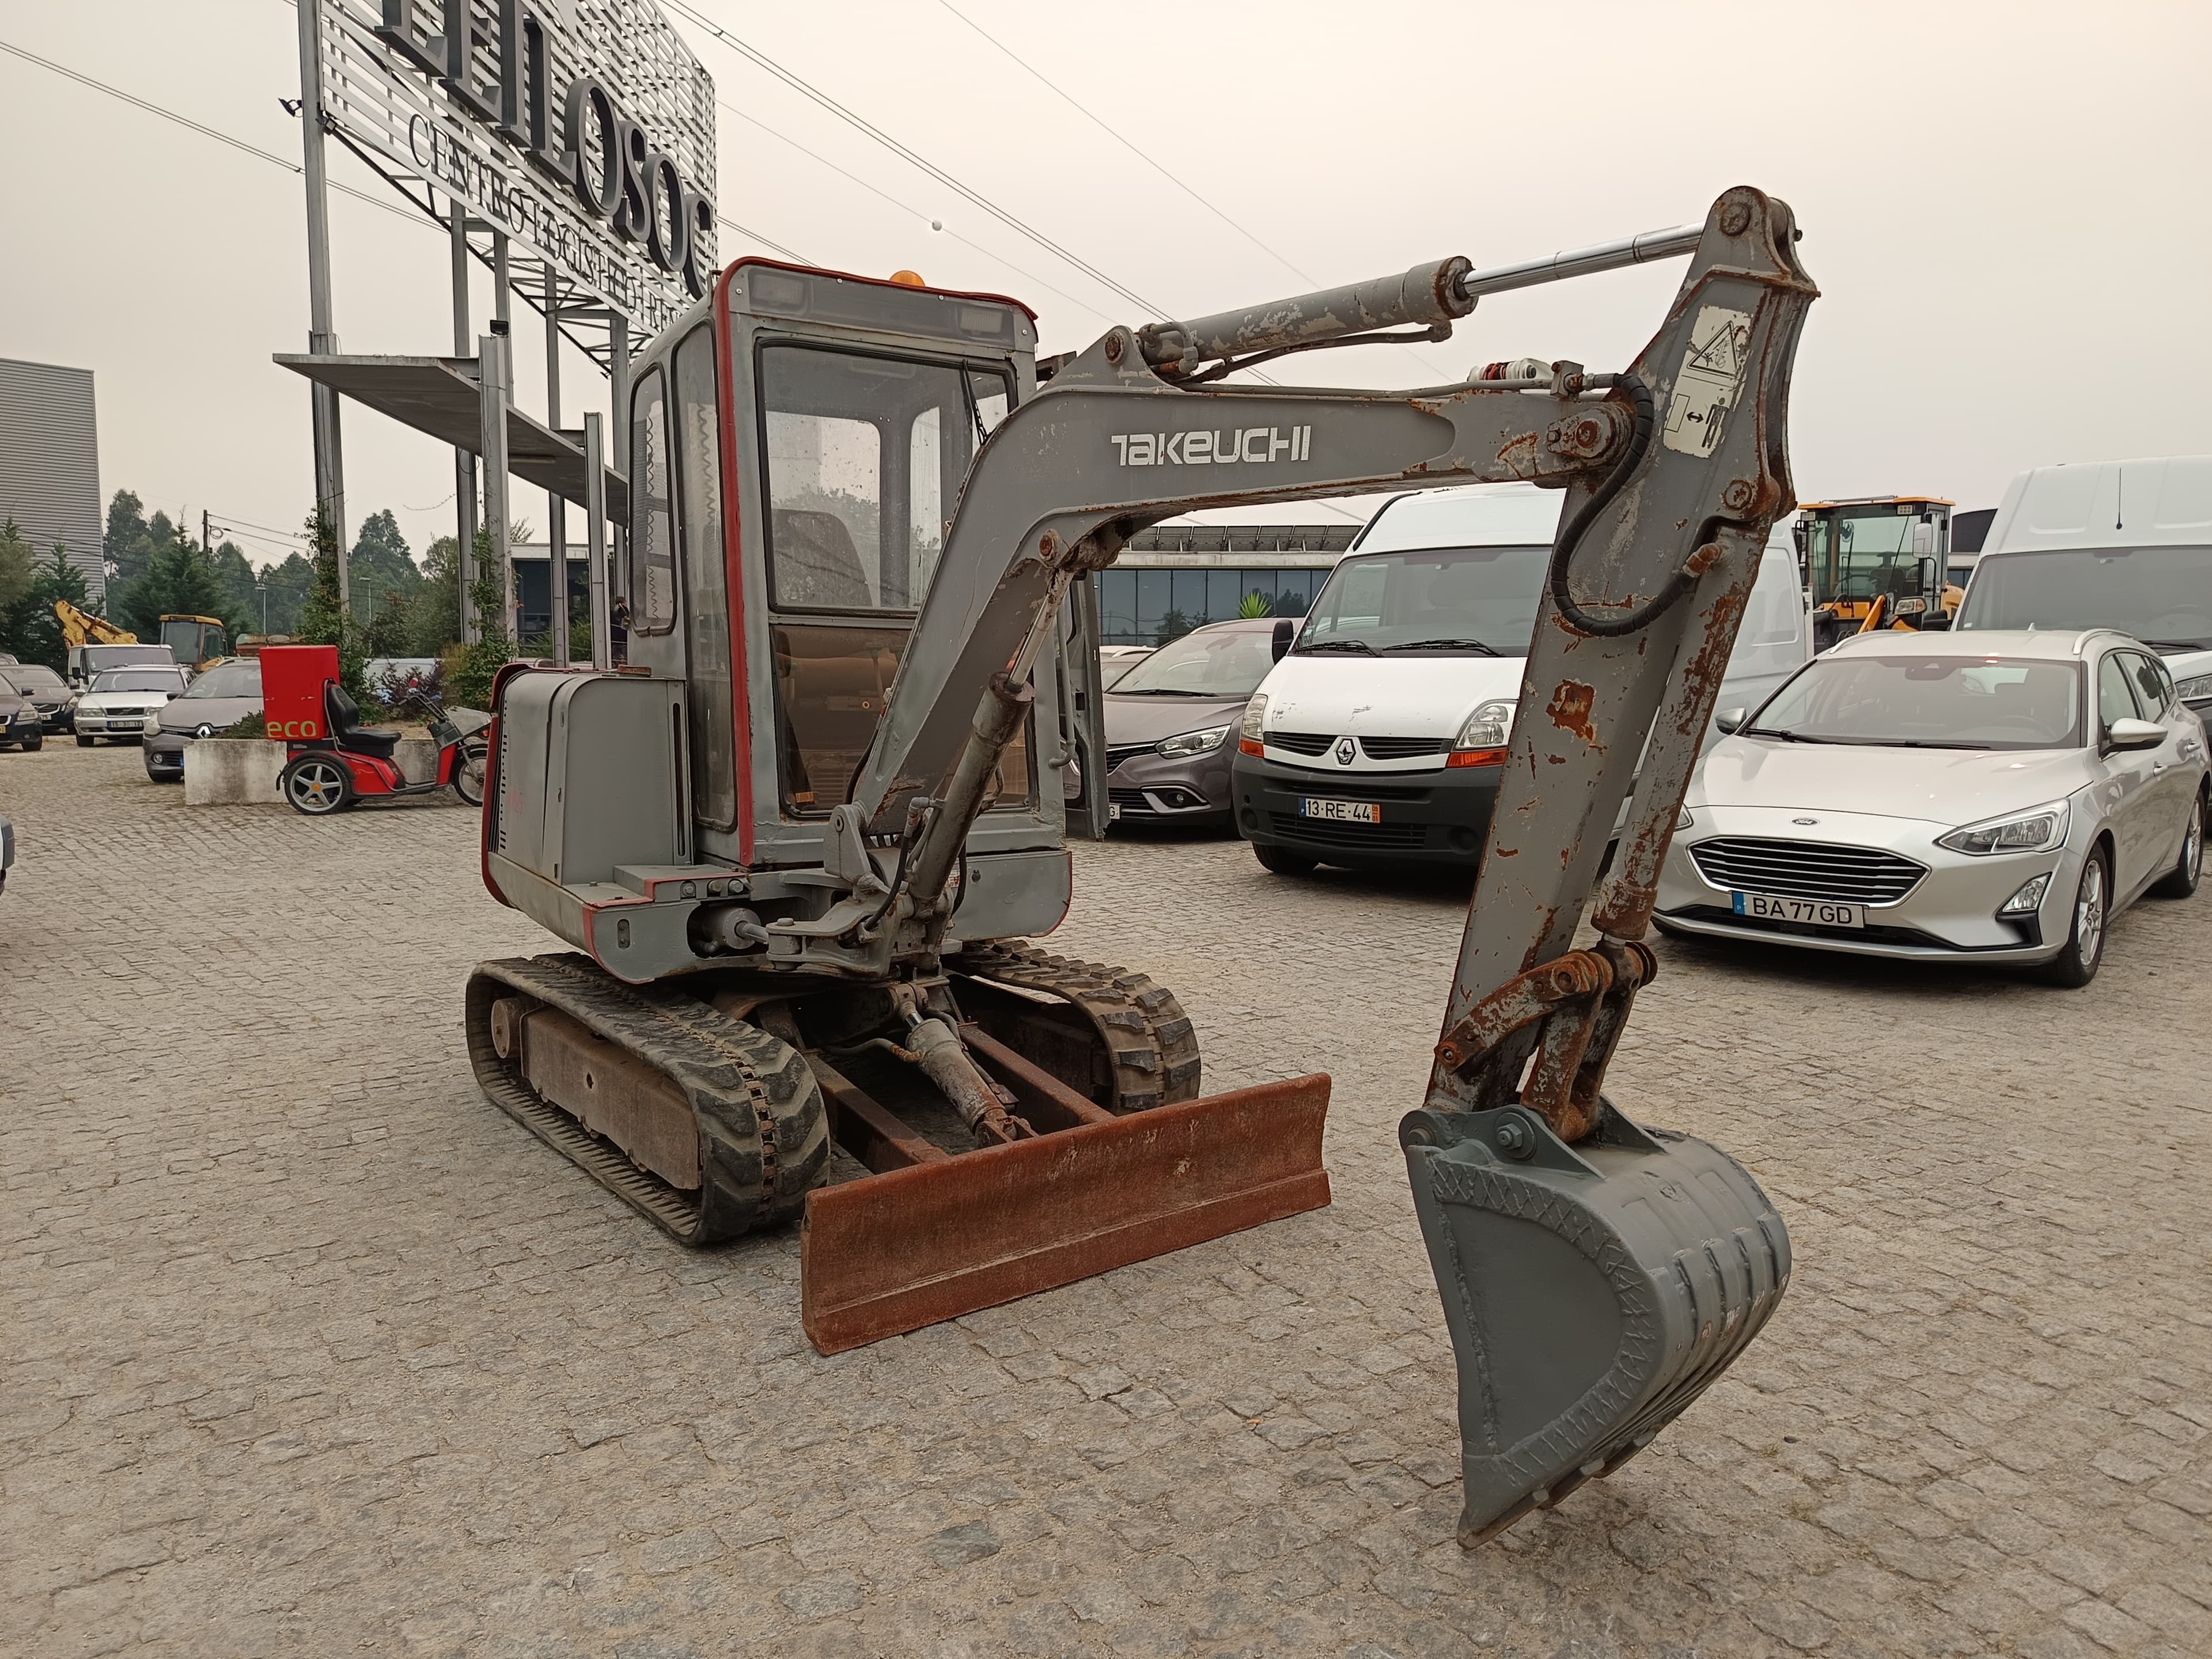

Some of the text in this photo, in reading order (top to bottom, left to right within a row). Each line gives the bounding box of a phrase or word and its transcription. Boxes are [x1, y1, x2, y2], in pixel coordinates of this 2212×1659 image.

[408, 113, 524, 234] CENTRO
[1111, 426, 1311, 466] TAKEUCHI
[267, 721, 316, 737] eco
[1753, 897, 1786, 918] BA
[1789, 902, 1815, 921] 77
[1819, 906, 1852, 925] GD
